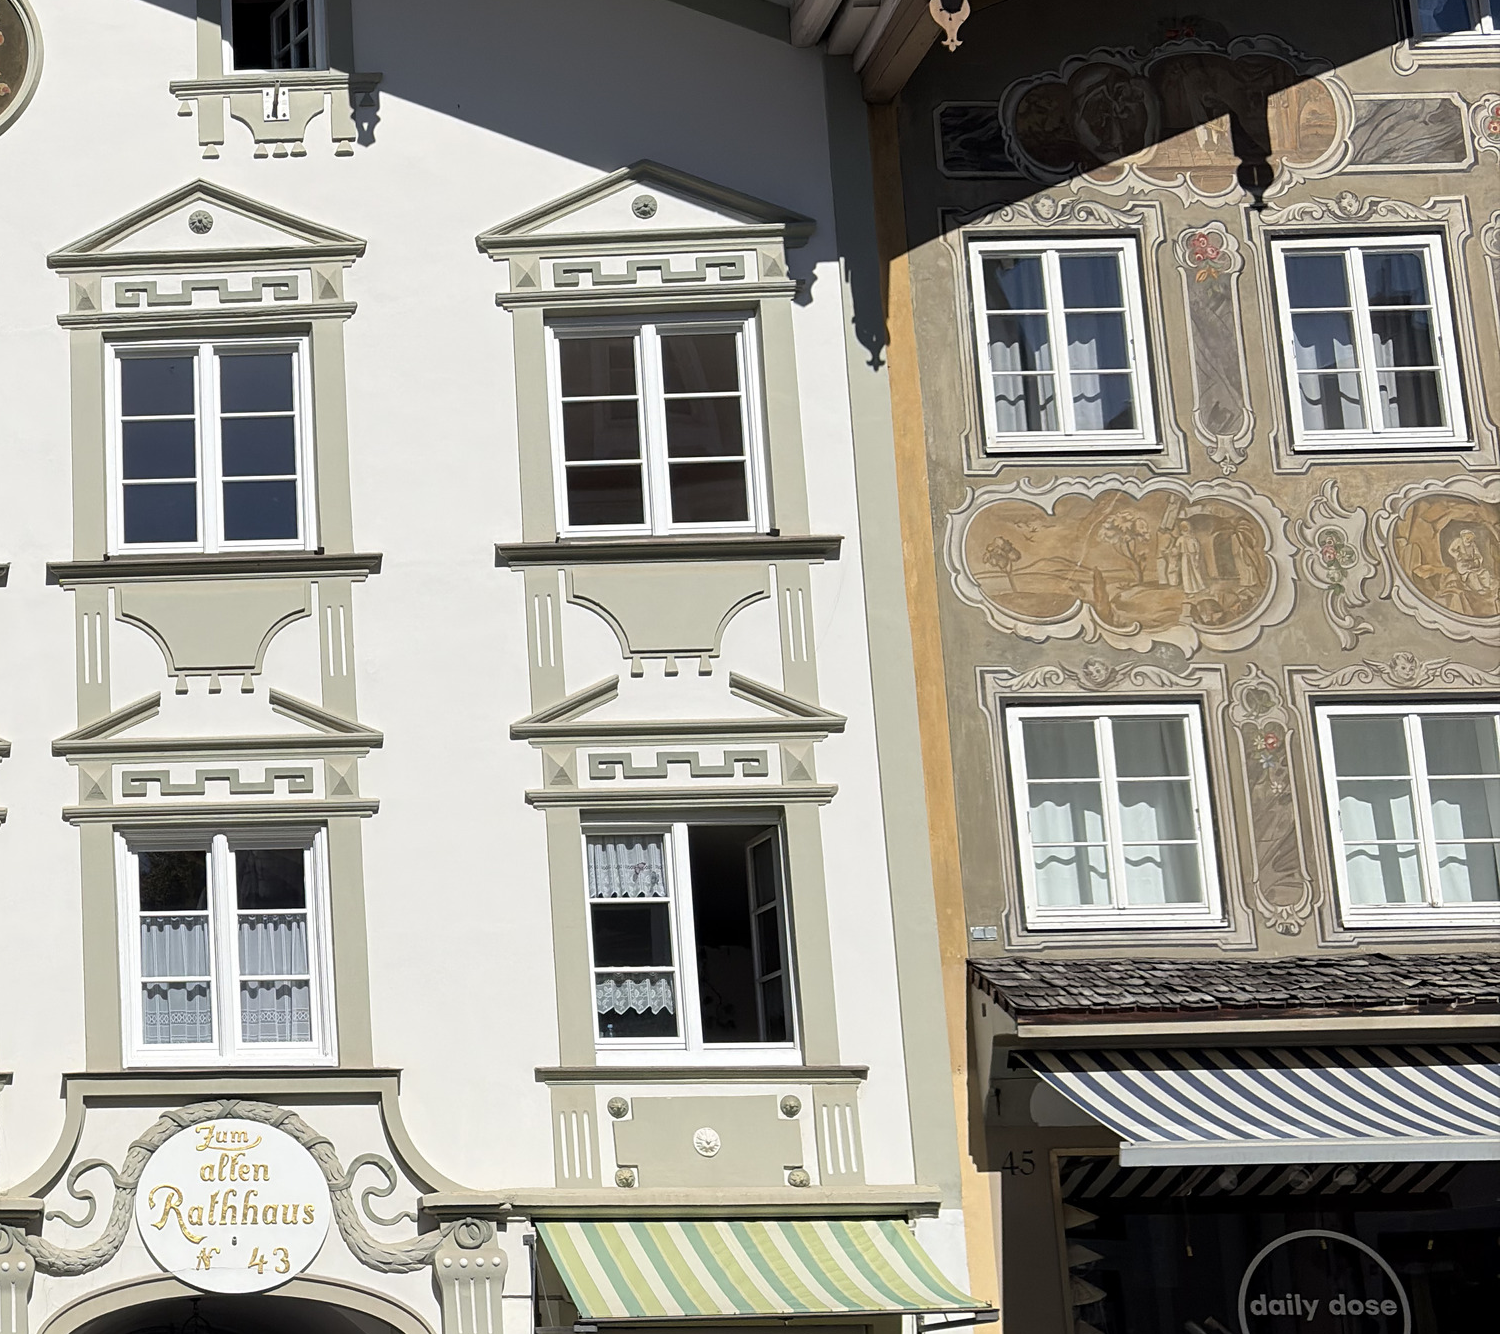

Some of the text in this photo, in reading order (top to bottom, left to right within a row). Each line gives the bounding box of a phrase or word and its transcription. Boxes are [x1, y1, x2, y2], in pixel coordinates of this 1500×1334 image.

[195, 1125, 263, 1151] Zum
[200, 1153, 270, 1182] alten
[1002, 1150, 1035, 1176] 45
[149, 1184, 315, 1244] Rathhaus
[248, 1247, 291, 1274] 43
[1250, 1293, 1398, 1322] daily dose
